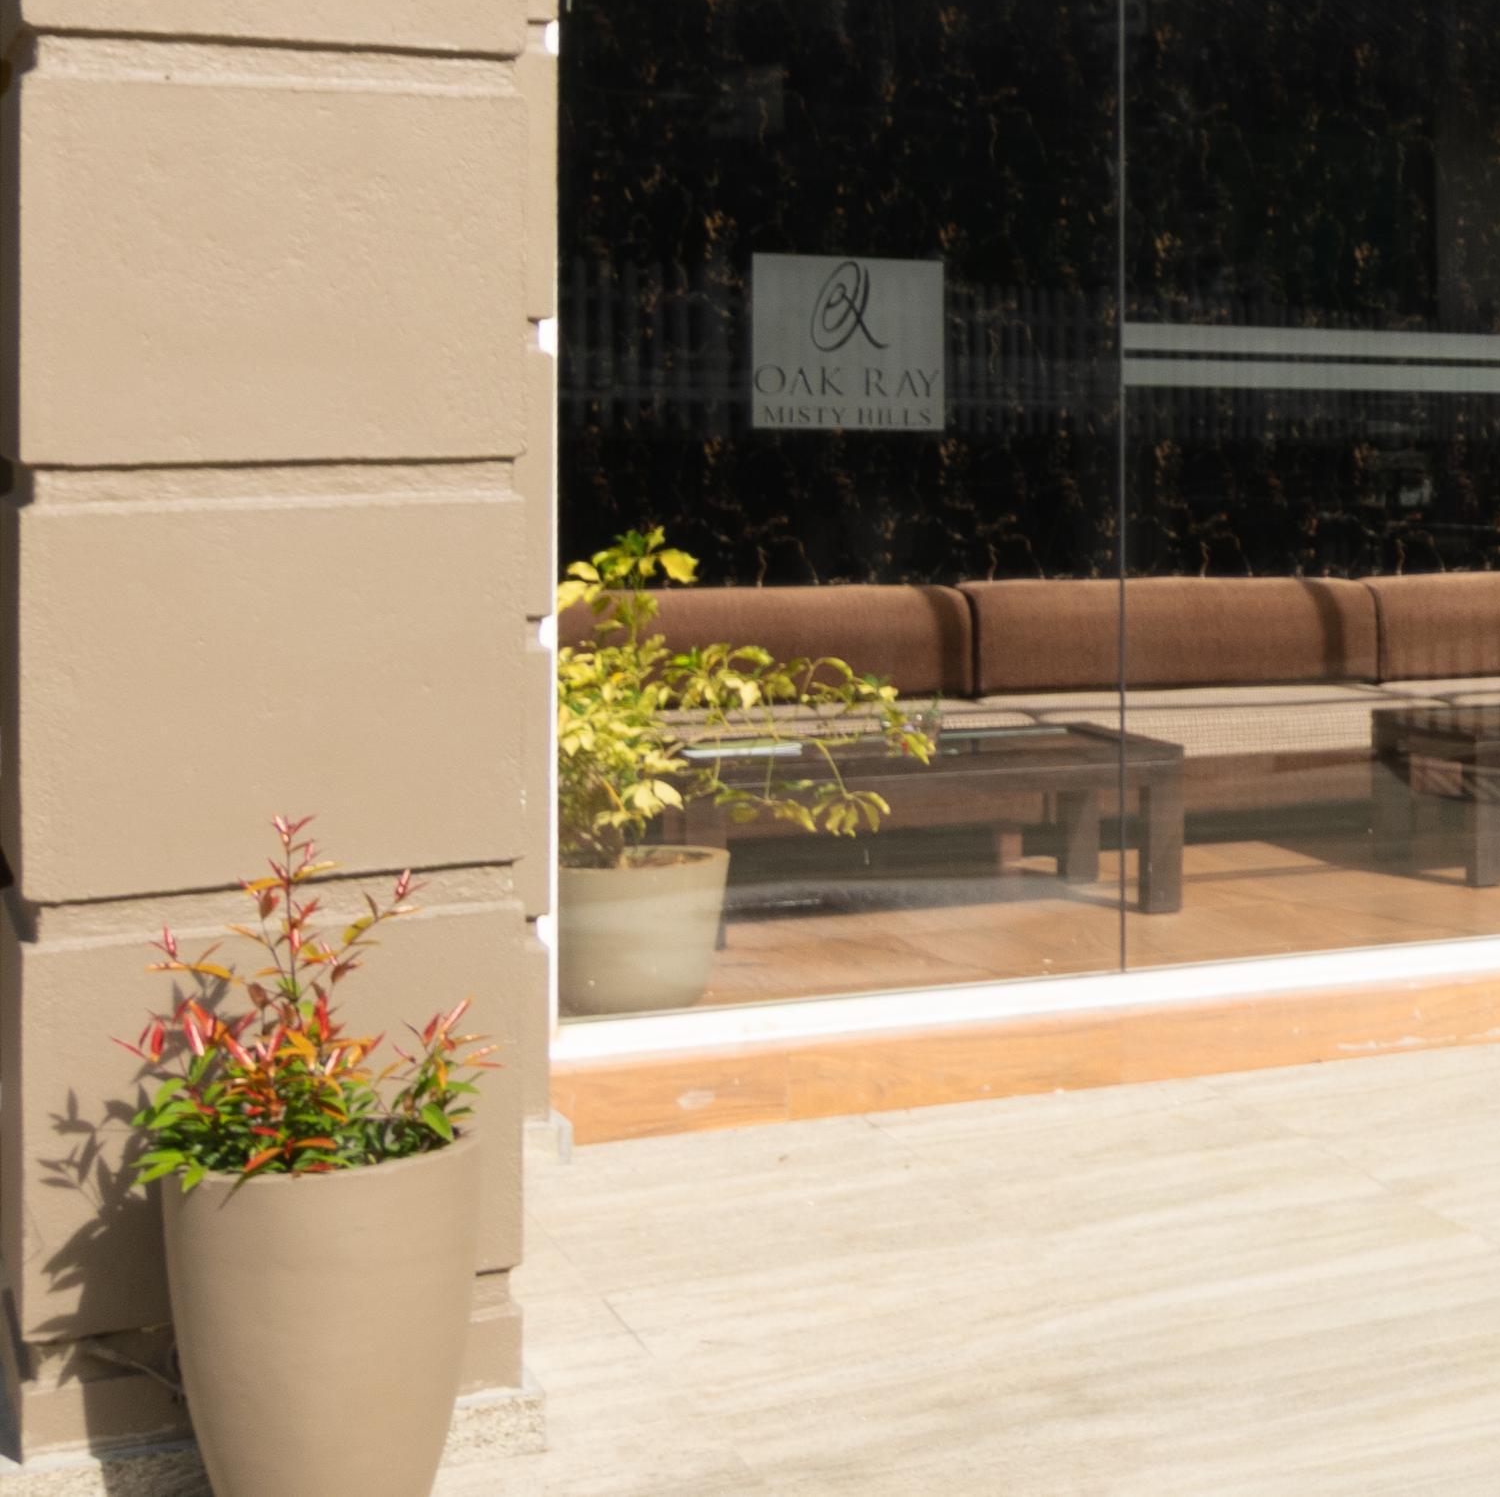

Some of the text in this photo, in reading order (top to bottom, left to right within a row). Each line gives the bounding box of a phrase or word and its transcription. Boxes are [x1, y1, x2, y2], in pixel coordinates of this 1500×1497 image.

[755, 364, 939, 398] OAK RAY
[764, 405, 845, 425] MISTY
